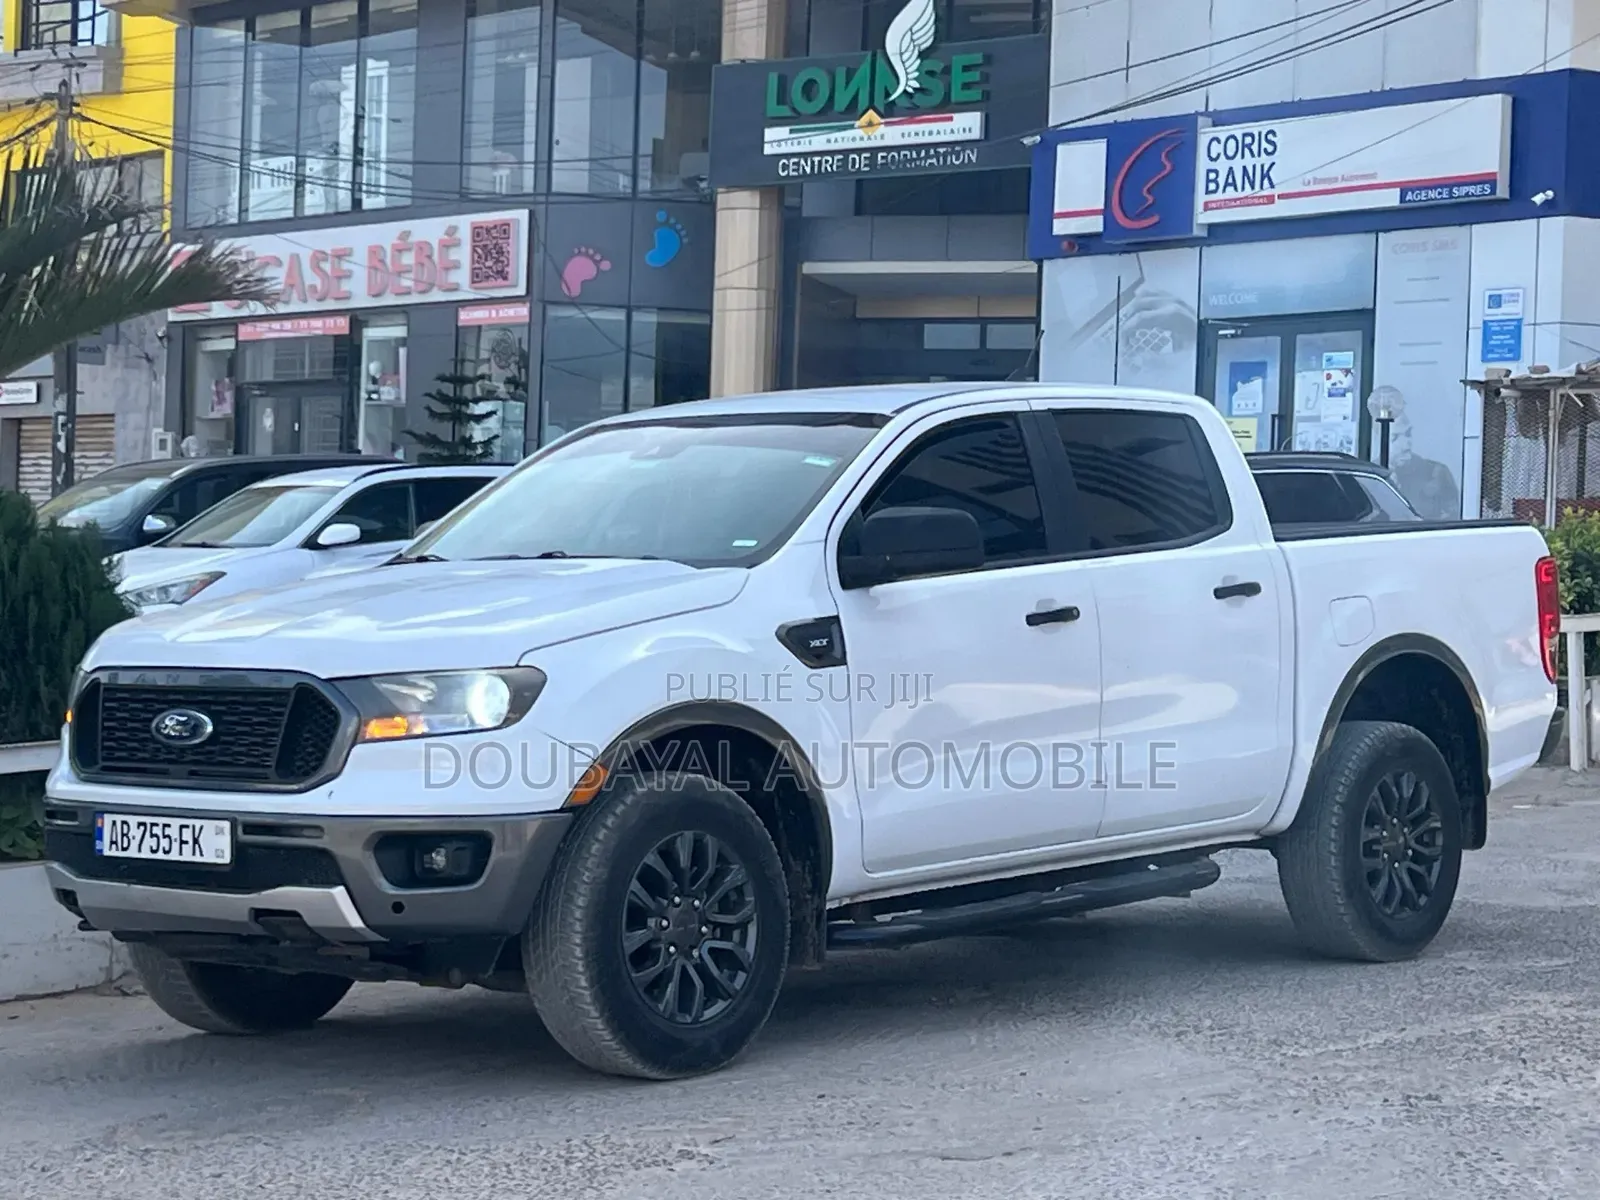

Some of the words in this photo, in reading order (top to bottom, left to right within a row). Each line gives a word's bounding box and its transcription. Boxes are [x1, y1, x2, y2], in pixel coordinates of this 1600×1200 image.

[826, 133, 885, 145] NATIONALE
[1207, 129, 1278, 163] CORIS
[778, 154, 843, 176] CENTRE
[848, 152, 871, 172] DE
[877, 146, 978, 169] FORMATION
[1205, 162, 1276, 195] BANK
[1406, 187, 1449, 202] AGENCE
[1452, 183, 1491, 197] SIPRES
[367, 225, 462, 297] BÉBÉ
[1208, 291, 1259, 306] WELCOME
[808, 638, 829, 648] XLT
